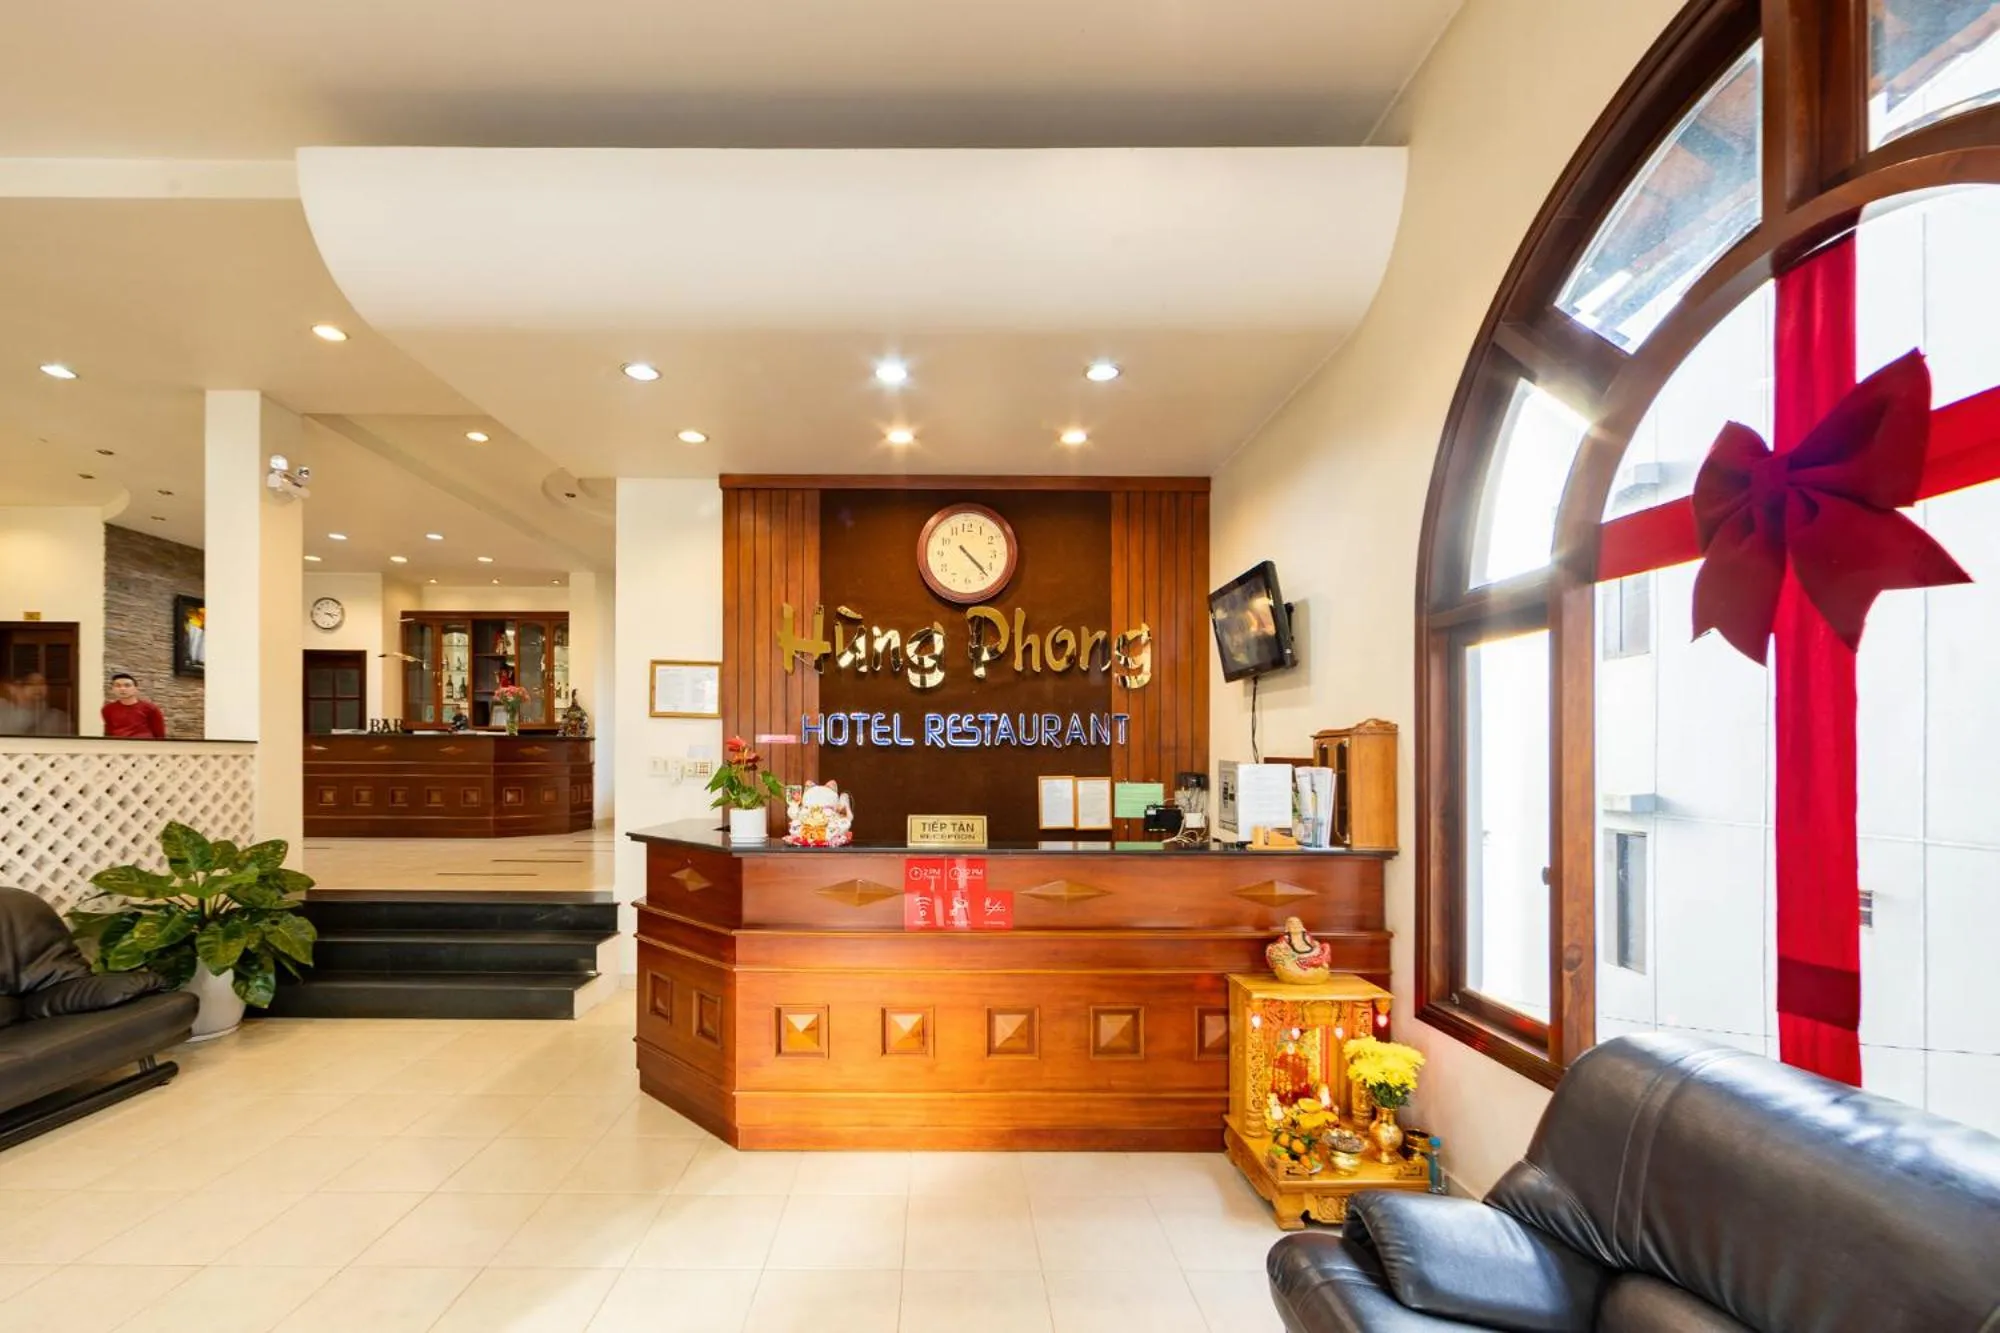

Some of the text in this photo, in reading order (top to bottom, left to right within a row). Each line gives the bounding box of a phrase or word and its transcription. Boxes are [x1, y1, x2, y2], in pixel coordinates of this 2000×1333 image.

[951, 526, 958, 536] 11
[962, 523, 974, 533] 12
[941, 537, 951, 547] 10
[987, 535, 995, 545] 2
[990, 549, 997, 559] 3
[966, 607, 1153, 689] Phong
[370, 718, 405, 734] BAR
[801, 713, 1130, 748] HOTEL RESTAURANT
